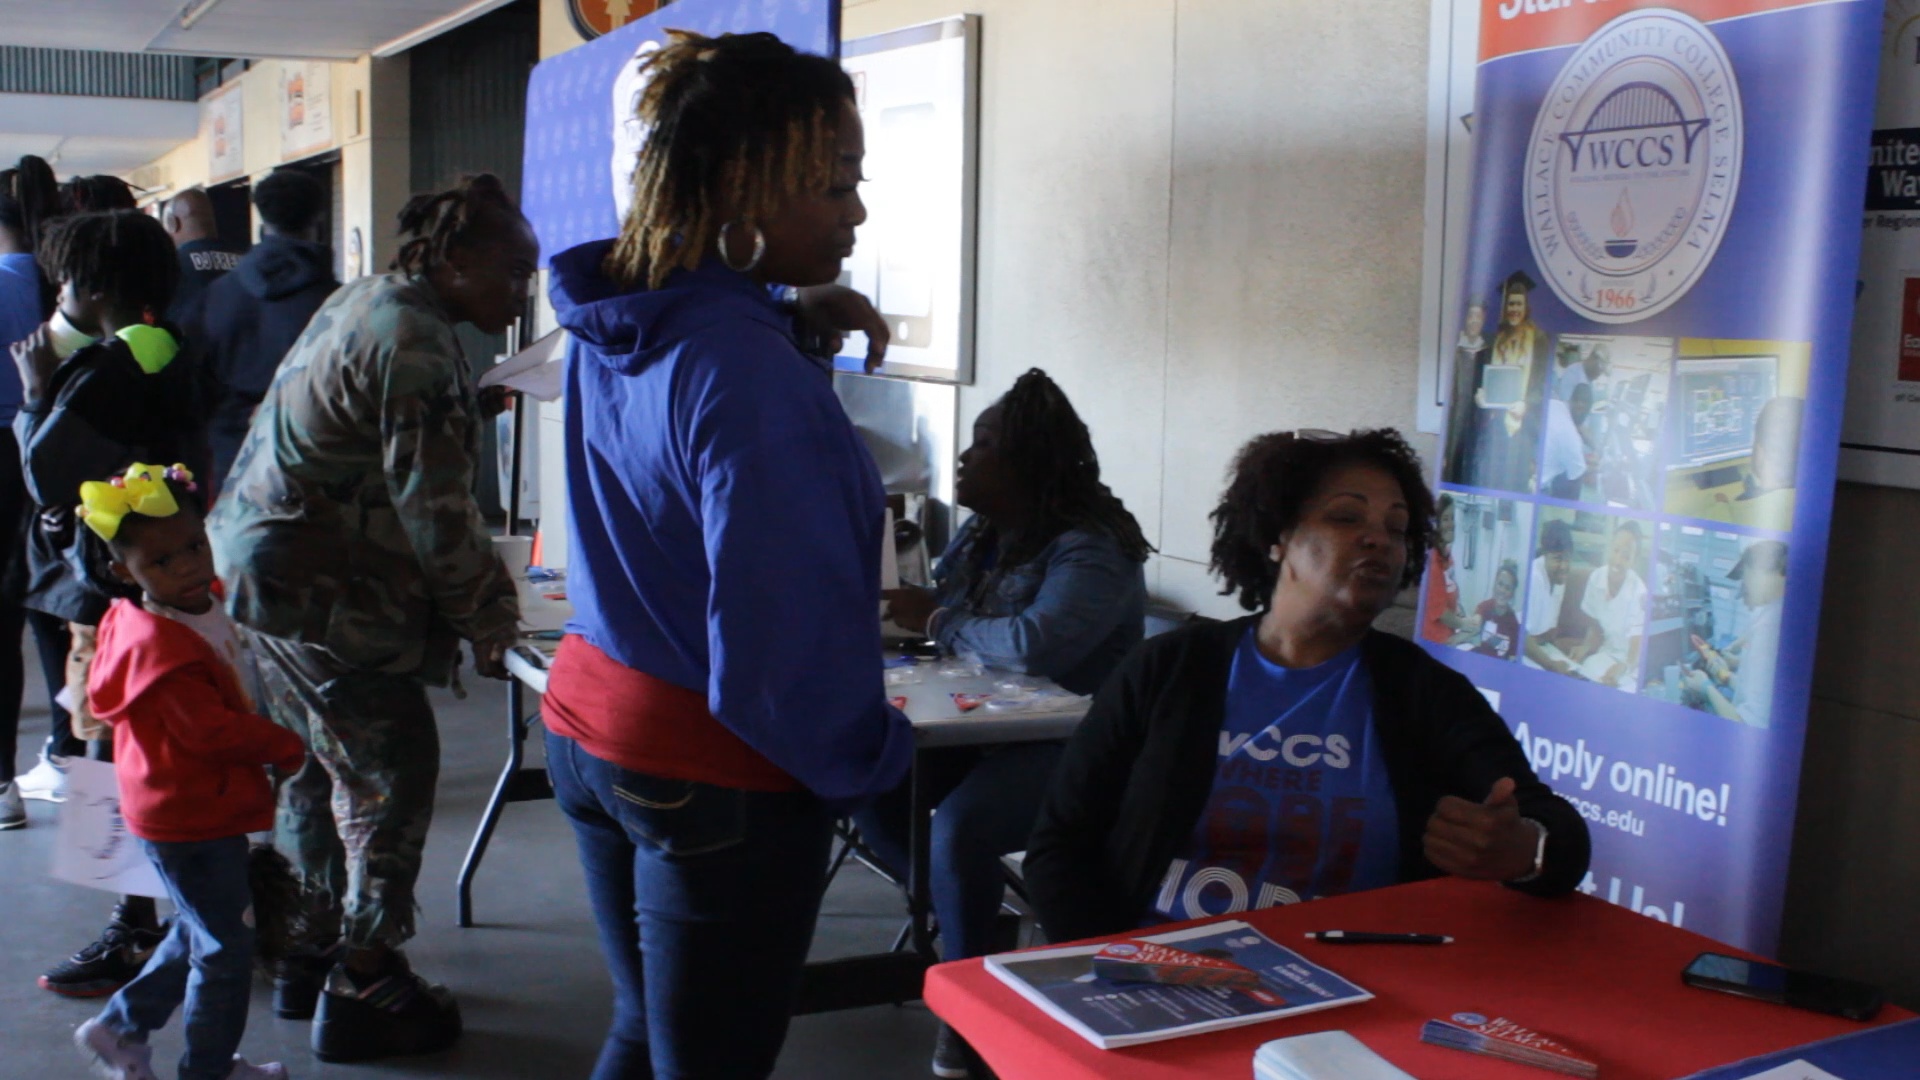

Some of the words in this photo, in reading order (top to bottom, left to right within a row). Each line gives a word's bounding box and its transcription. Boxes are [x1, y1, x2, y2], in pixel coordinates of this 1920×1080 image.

[1553, 27, 1671, 119] COMMUNITY
[1673, 34, 1729, 143] COLLEGE
[1588, 134, 1674, 170] WCCS
[1868, 139, 1920, 166] nite
[1535, 130, 1560, 257] WALLACE
[1687, 155, 1728, 250] SELMA
[1880, 170, 1920, 204] Wa
[1596, 289, 1636, 309] 1966
[1514, 721, 1604, 791] Apply
[1610, 762, 1730, 827] online!
[1553, 791, 1645, 837] ccs.edu
